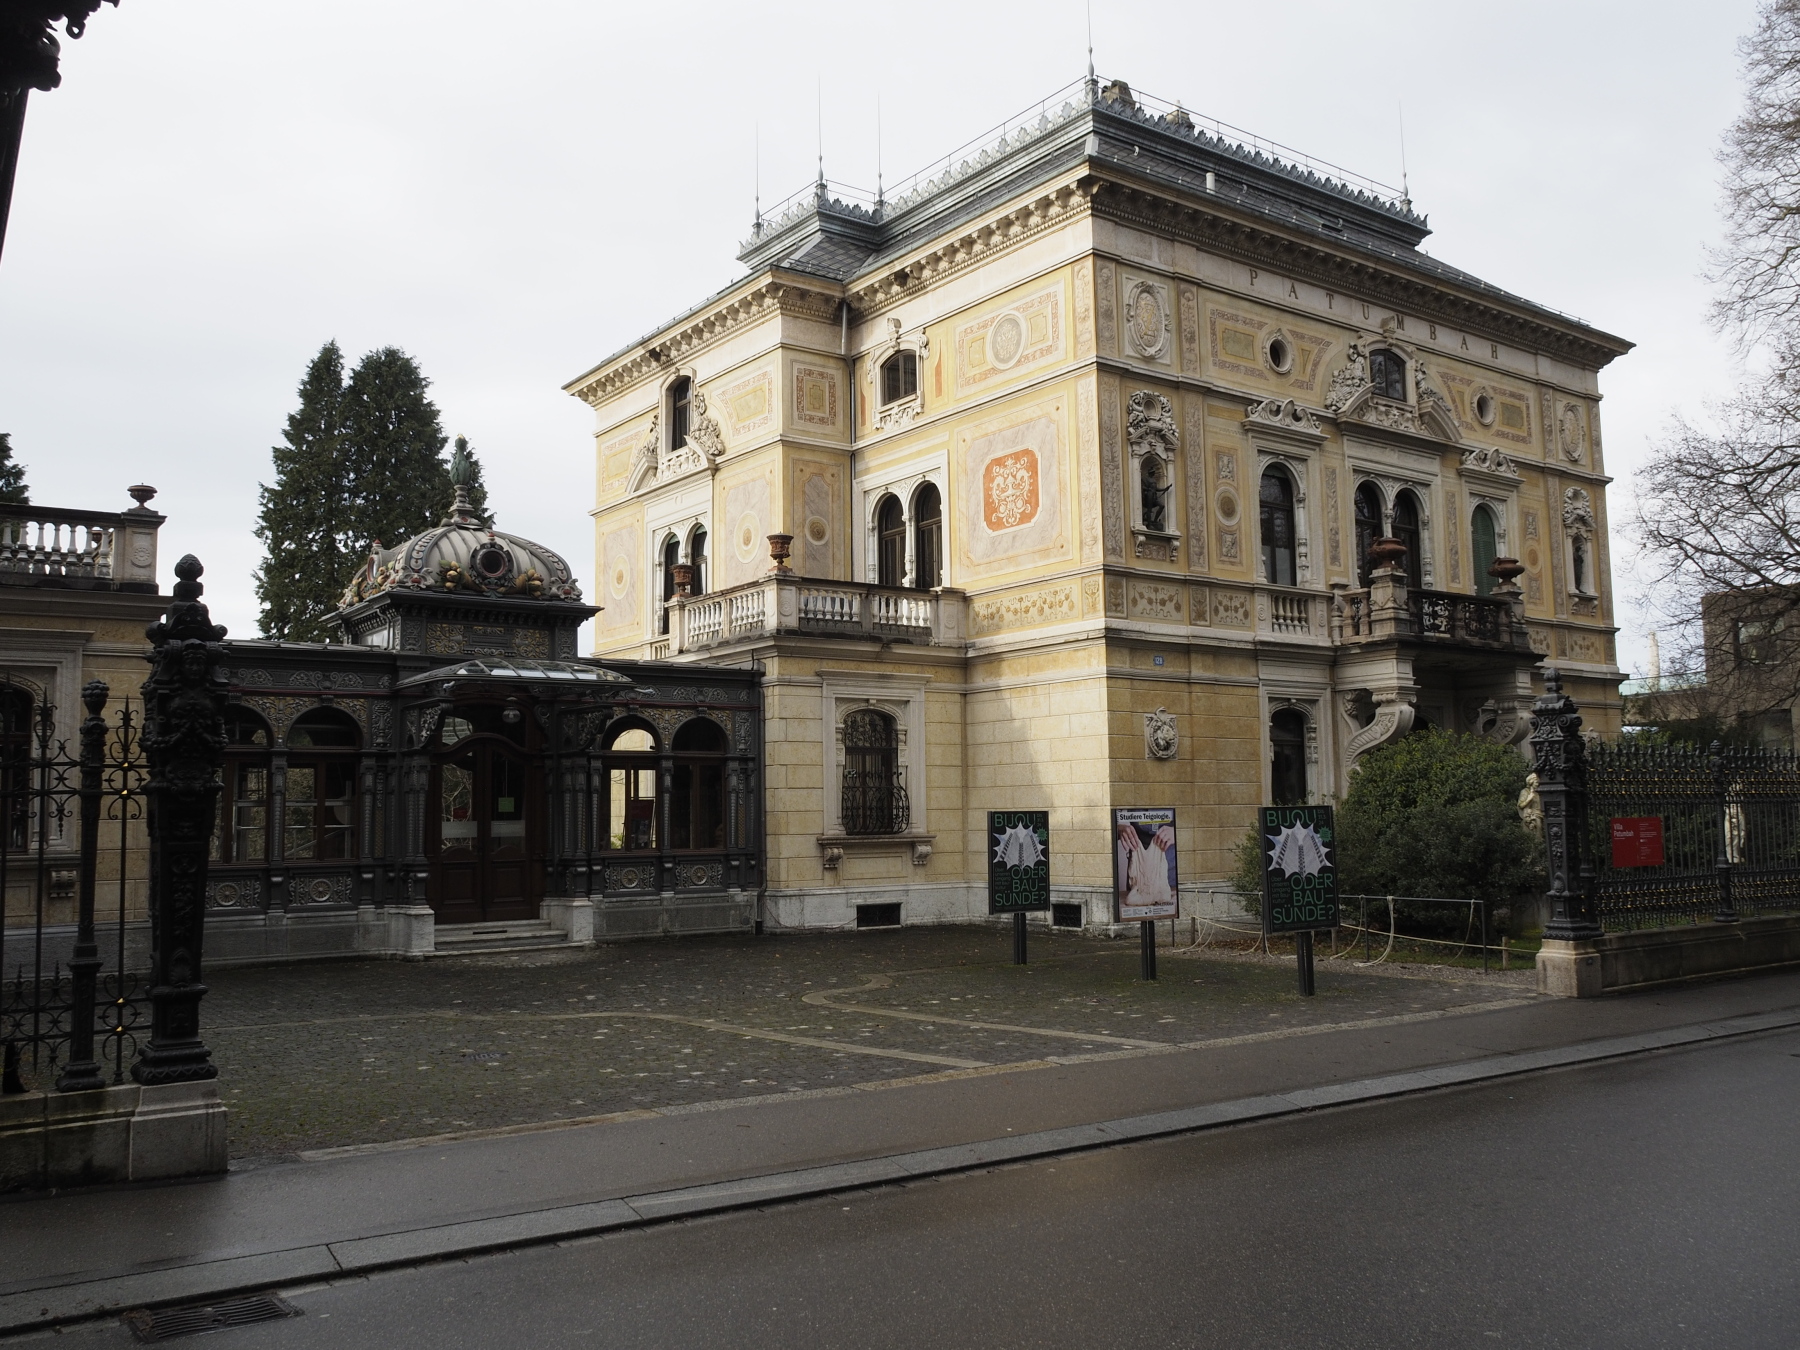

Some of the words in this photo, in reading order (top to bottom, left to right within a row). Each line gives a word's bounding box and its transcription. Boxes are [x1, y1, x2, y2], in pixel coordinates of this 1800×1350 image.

[1248, 268, 1499, 361] PATUMBAH
[994, 813, 1036, 827] BIJOU
[1119, 813, 1142, 821] Studiere
[1266, 809, 1316, 827] BIJOU
[1011, 866, 1047, 879] ODER
[1290, 873, 1334, 890] ODER
[995, 890, 1047, 906] SÜNDE?
[1272, 904, 1335, 923] SÜNDE?
